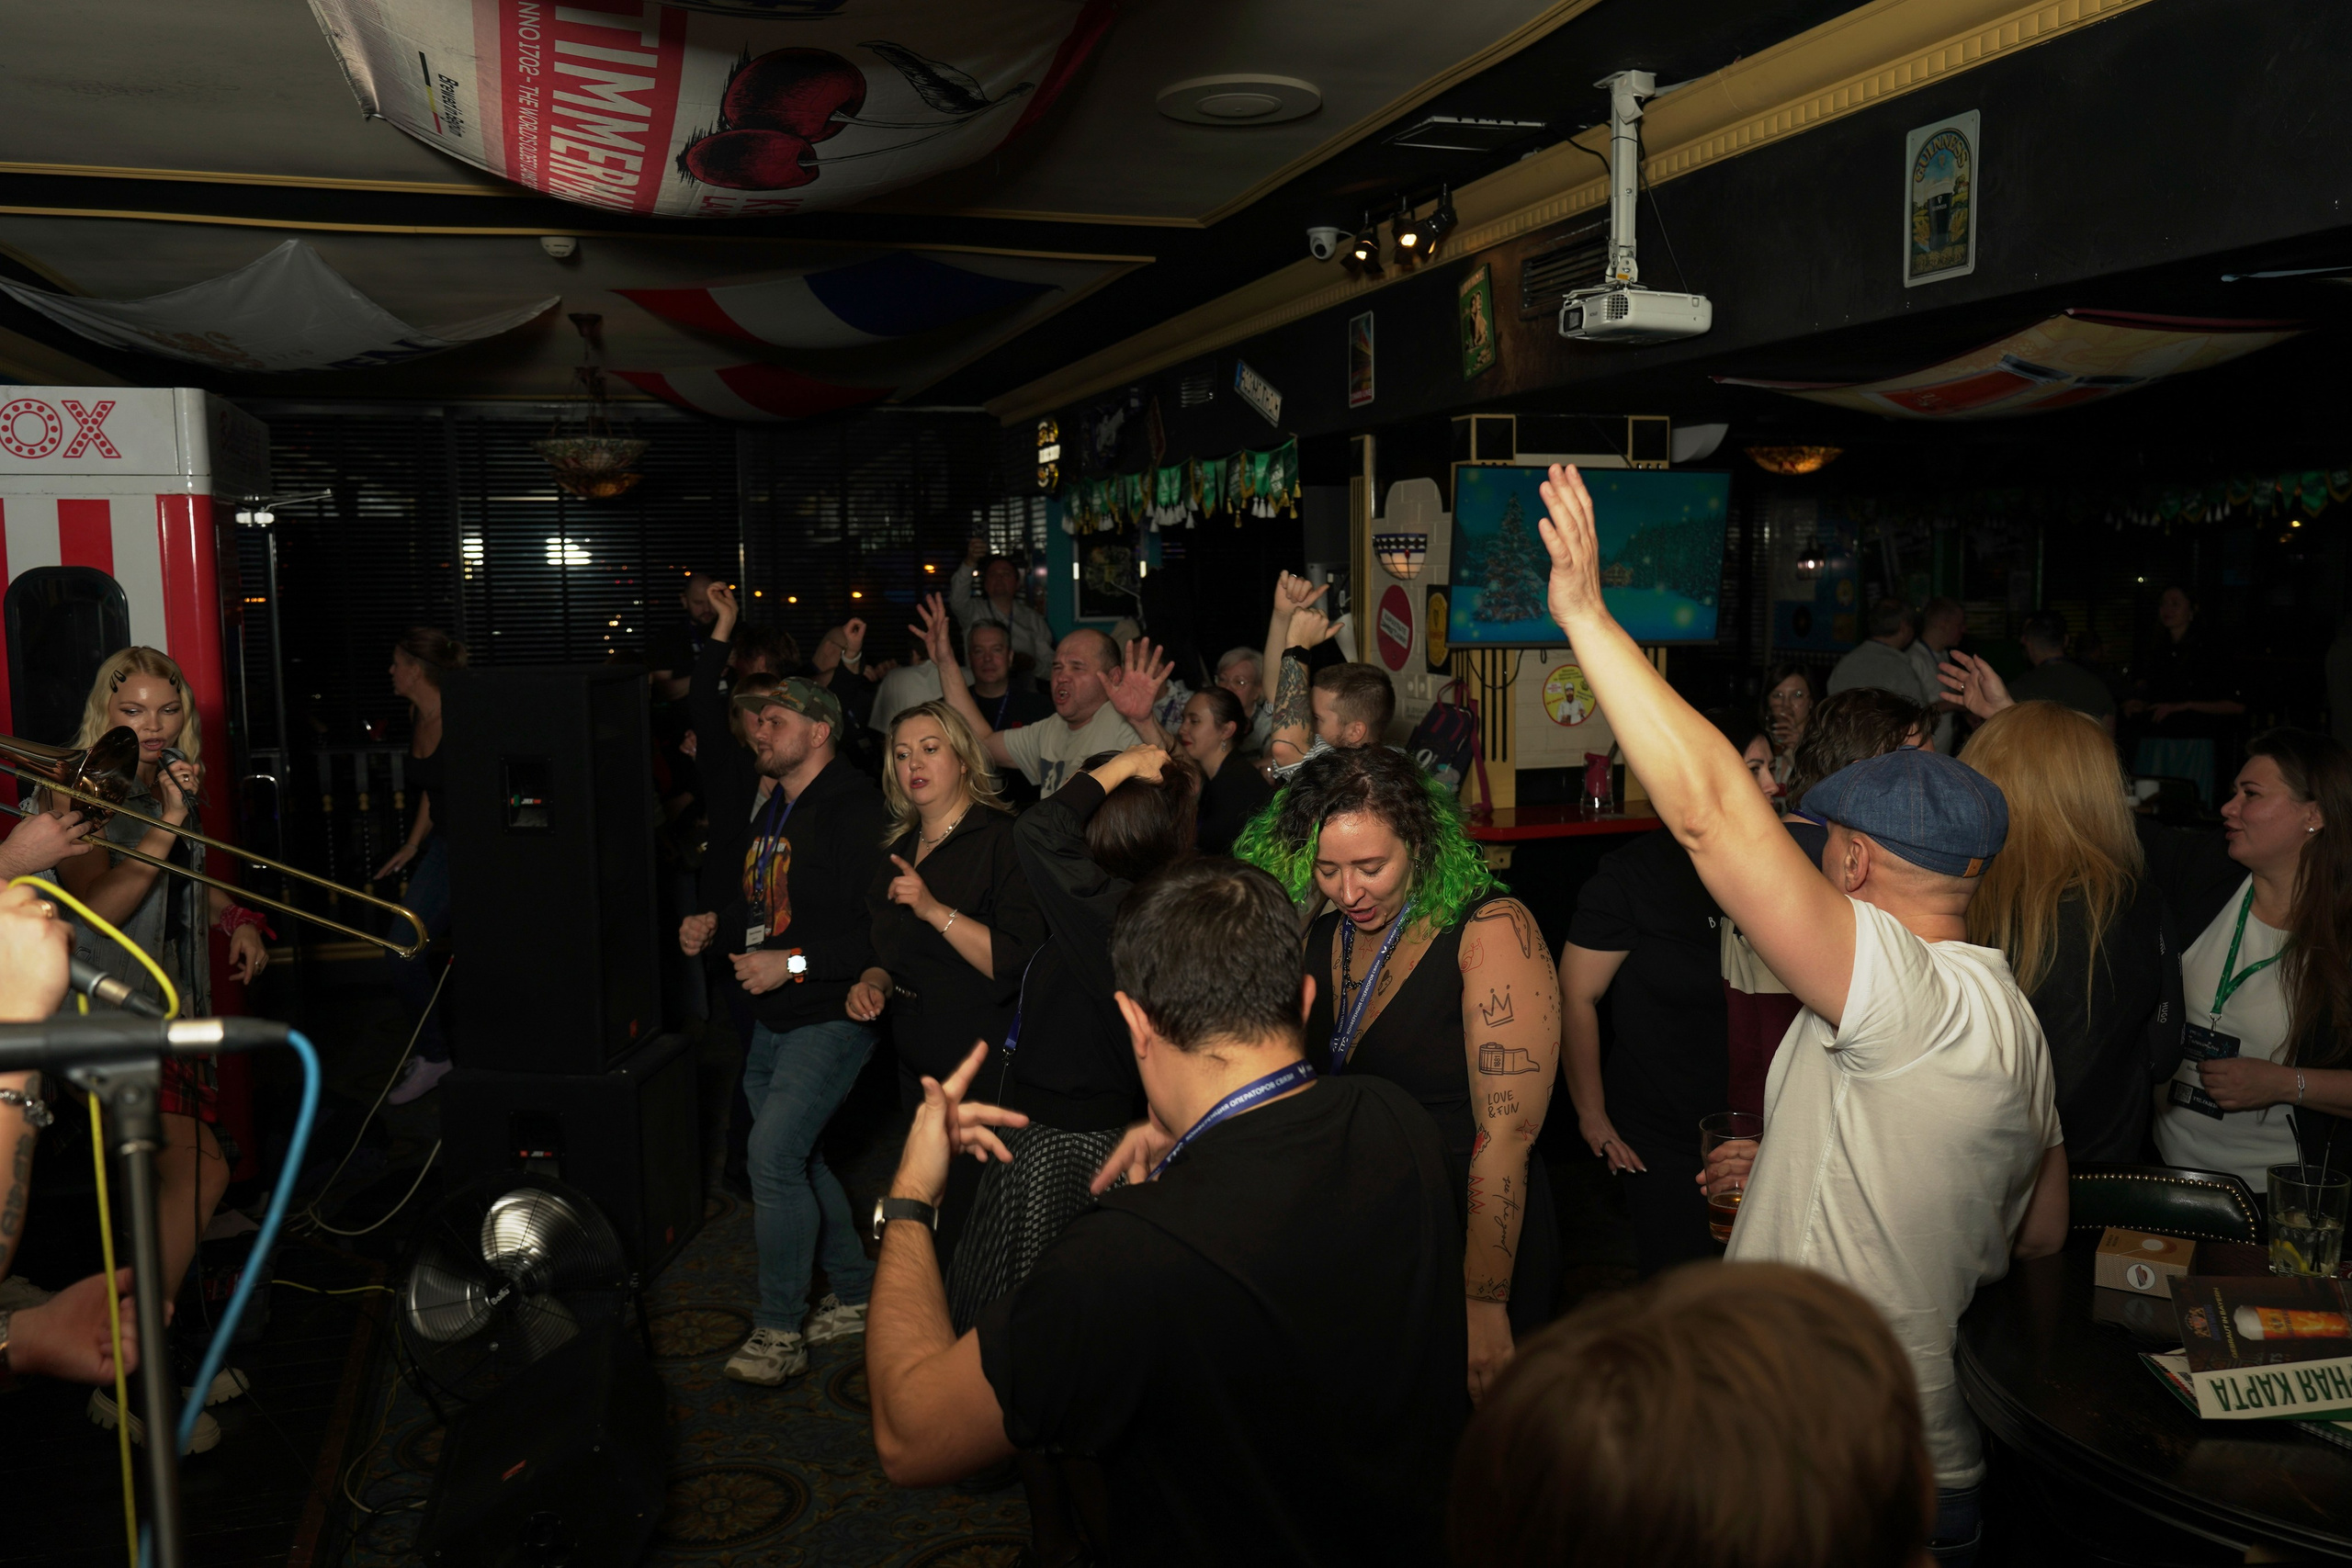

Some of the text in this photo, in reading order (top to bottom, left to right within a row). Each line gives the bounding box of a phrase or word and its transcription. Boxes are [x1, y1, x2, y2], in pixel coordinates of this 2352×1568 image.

[518, 42, 540, 75] 1702
[438, 73, 460, 107] Brewed
[518, 85, 539, 107] THE
[1915, 133, 1968, 183] GUINNESS
[0, 399, 121, 458] OX
[1346, 1001, 1363, 1035] КОНФЕРЕНЦИЯ
[1360, 974, 1375, 1003] ОПЕРАТОРОВ
[1372, 960, 1381, 975] СВЯЗИ
[2160, 1001, 2169, 1023] HUGO
[1229, 1080, 1276, 1108] ОПЕРАТОРОВ
[1487, 1089, 1514, 1105] LOVE
[1493, 1176, 1521, 1258] see the good
[2212, 1287, 2227, 1316] BAYERN
[2223, 1325, 2239, 1359] GEBRAUT
[2210, 1371, 2297, 1411] КАРТА
